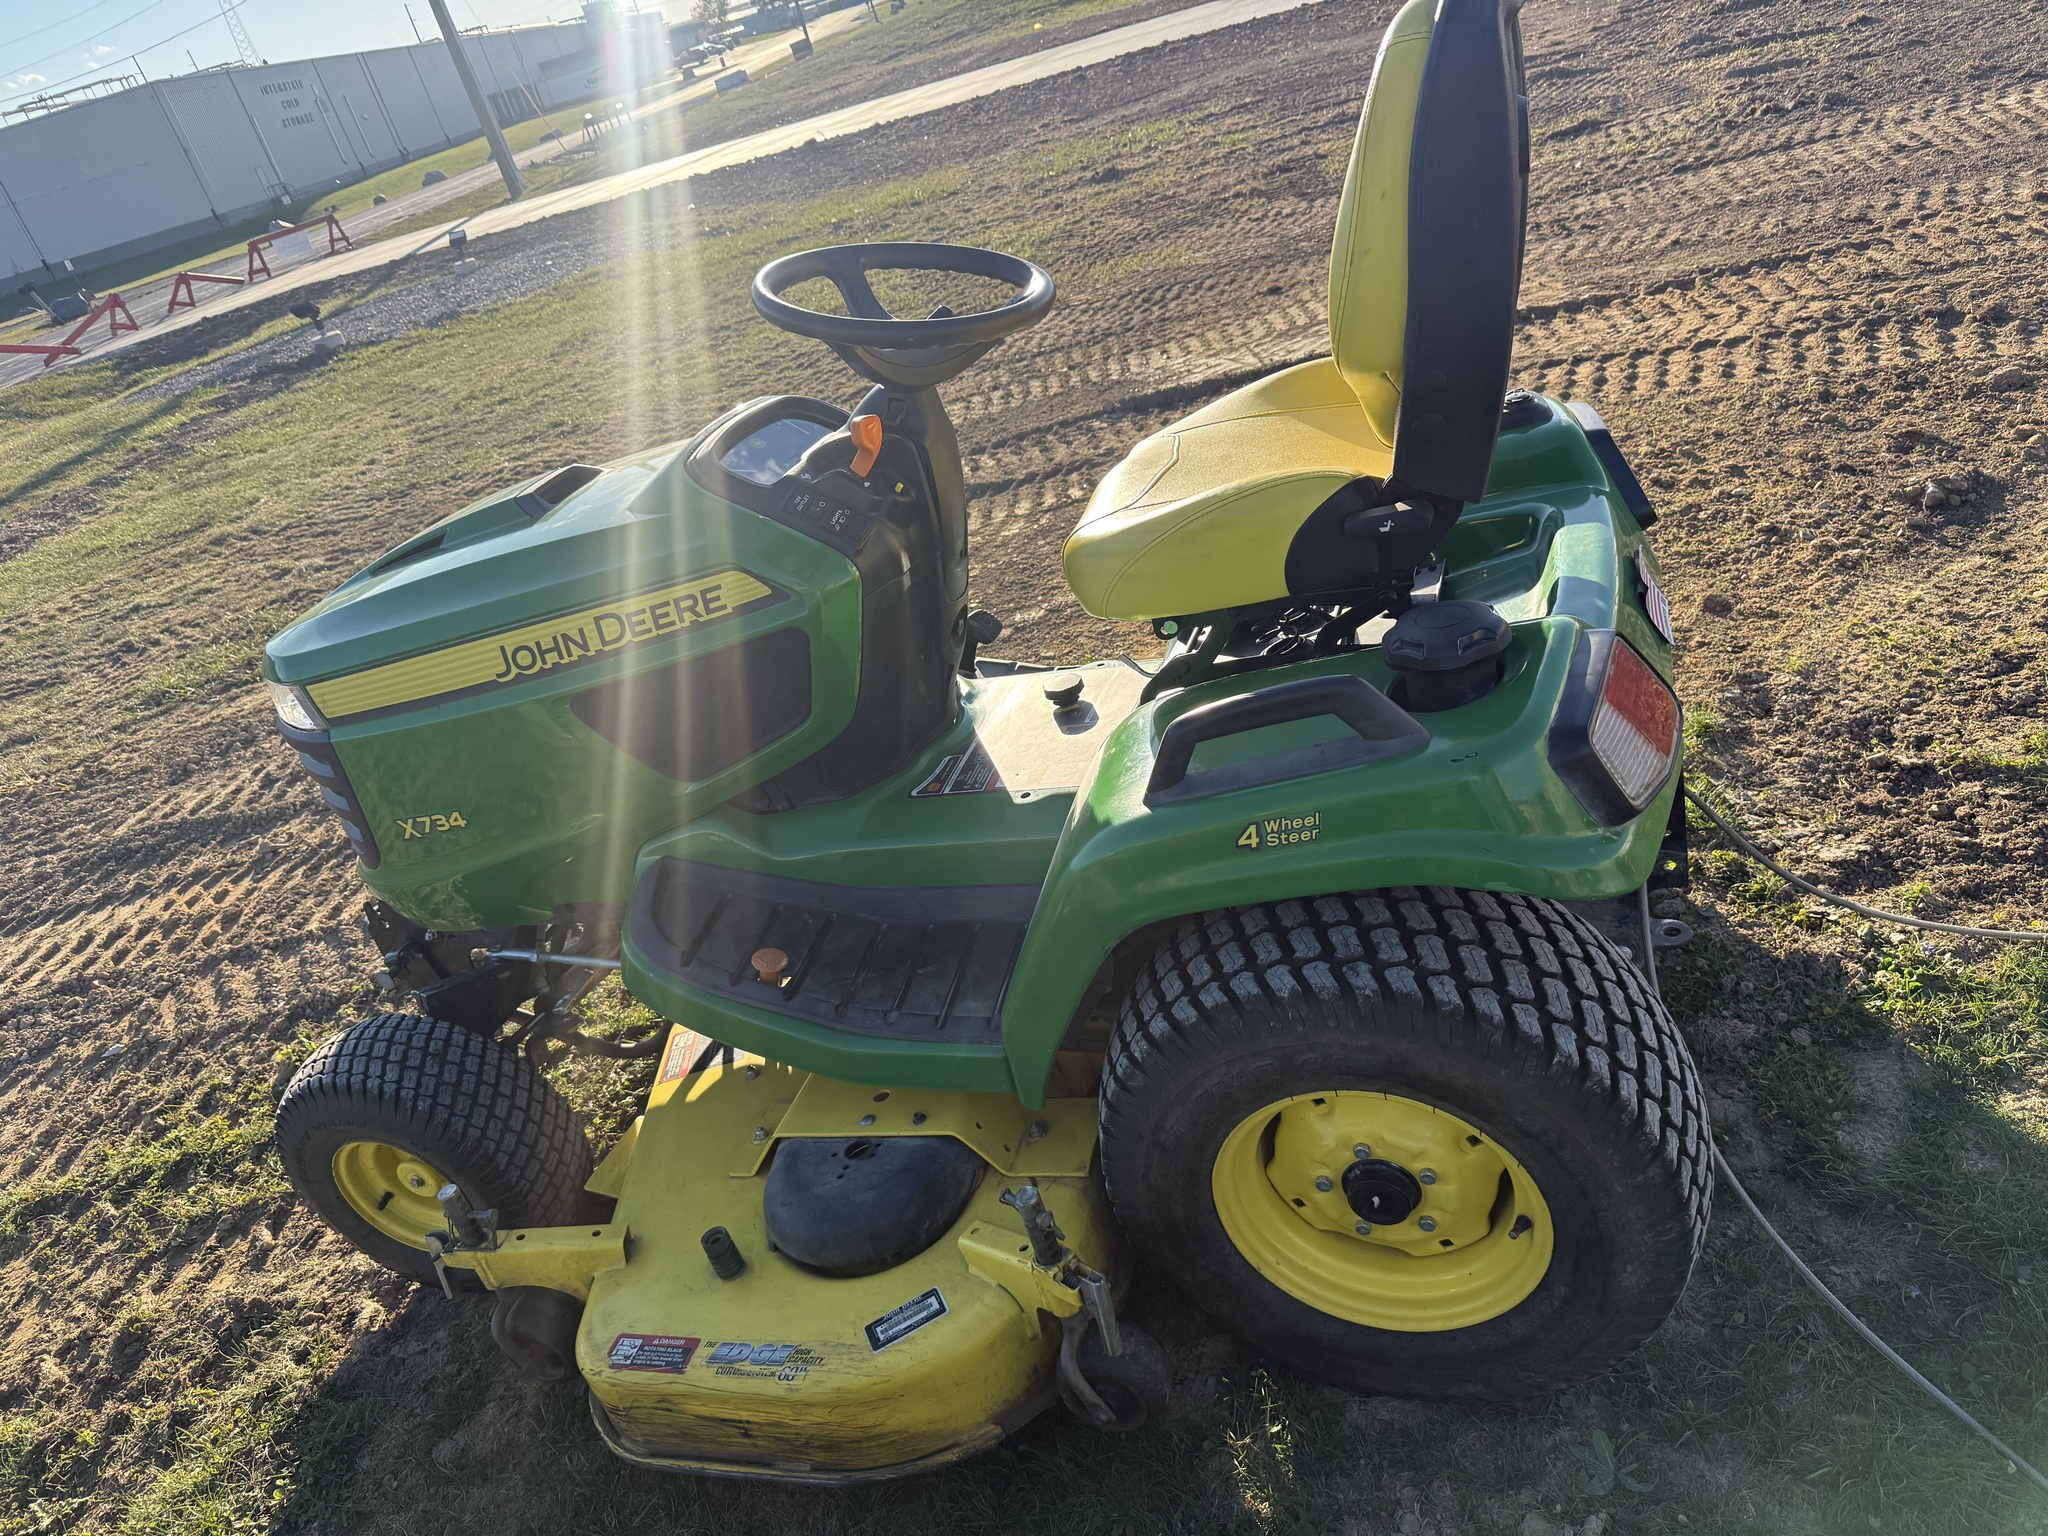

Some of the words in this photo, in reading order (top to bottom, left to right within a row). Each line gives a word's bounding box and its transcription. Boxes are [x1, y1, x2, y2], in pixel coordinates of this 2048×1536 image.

[260, 79, 303, 96] INTERSTATE
[281, 98, 300, 110] COLD
[281, 112, 314, 129] STORAGE
[797, 494, 810, 511] OUTLET
[830, 510, 843, 525] LIGHTS
[495, 627, 591, 680] JOHN
[593, 583, 728, 648] DEERE
[396, 811, 468, 839] X734
[1238, 824, 1260, 848] 4
[1264, 812, 1320, 833] Wheel
[1266, 828, 1320, 847] Steer
[659, 1337, 686, 1346] DANGER
[705, 1342, 798, 1366] EDGE
[787, 1355, 826, 1364] CAPACITY
[792, 1348, 813, 1356] HIGH
